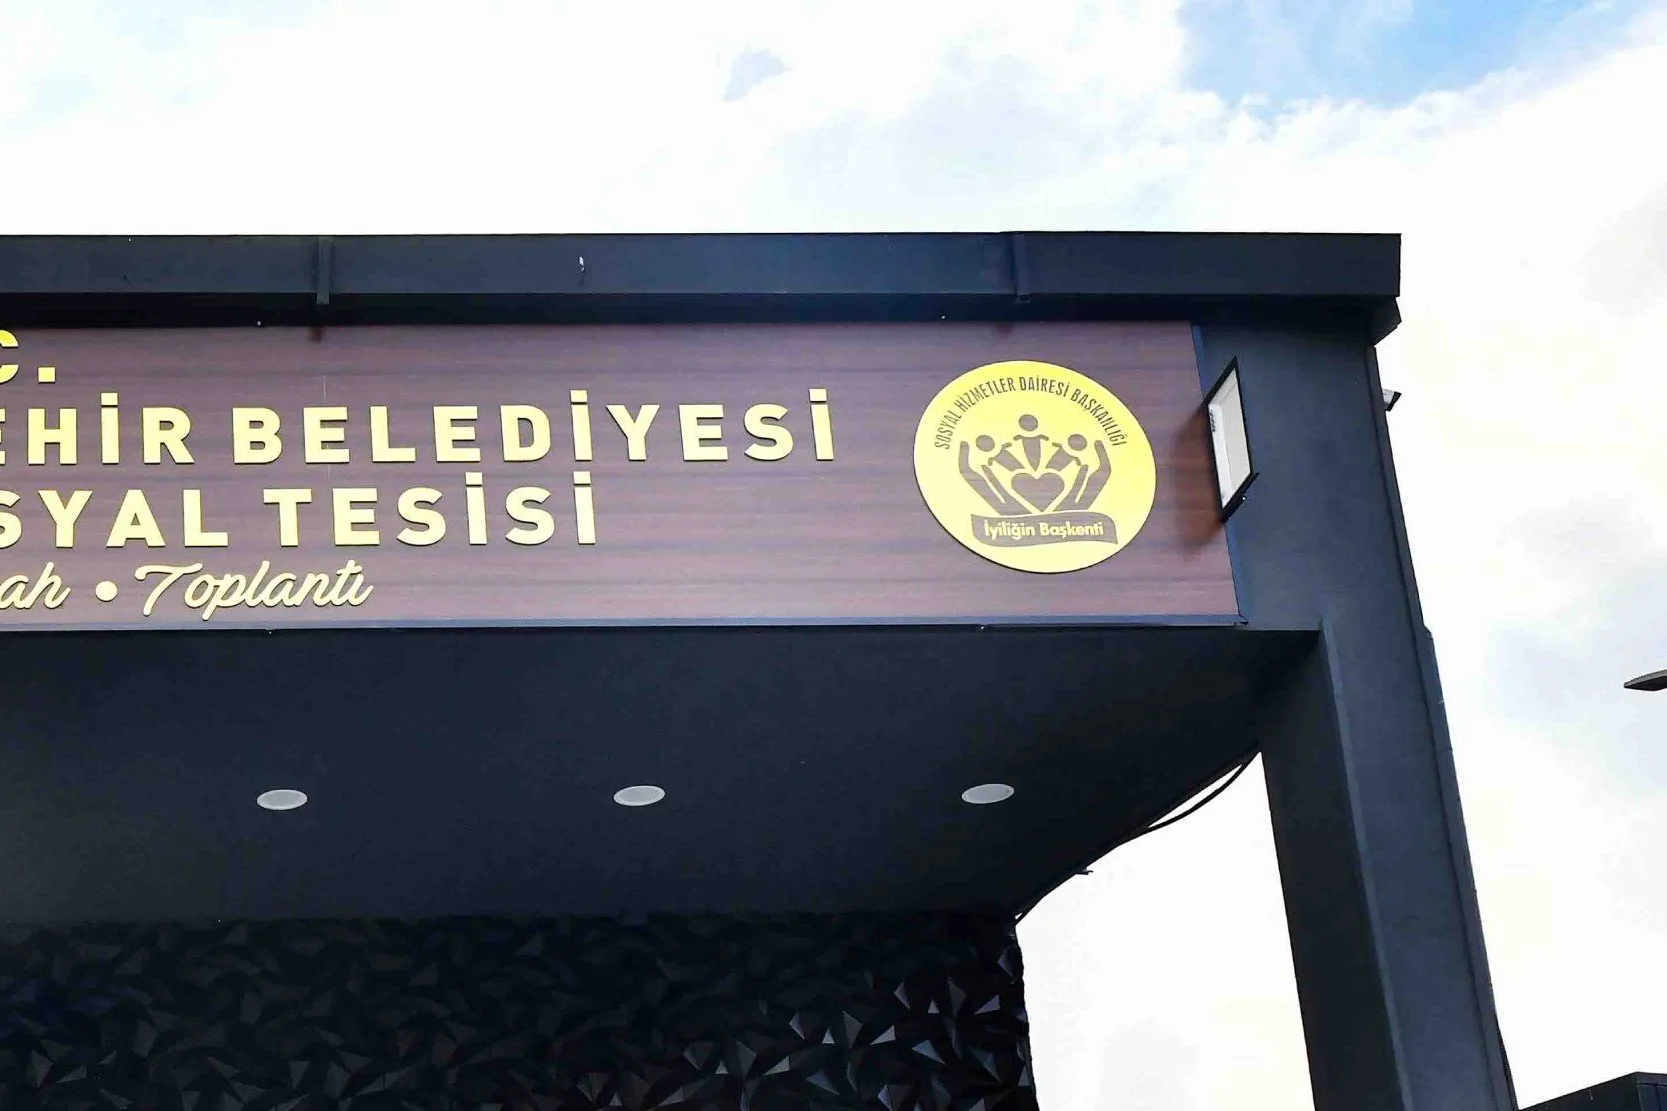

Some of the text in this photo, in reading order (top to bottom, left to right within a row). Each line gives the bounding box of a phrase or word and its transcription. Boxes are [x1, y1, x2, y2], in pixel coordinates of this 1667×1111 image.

[233, 388, 835, 464] BELEDİYESİ
[934, 374, 1128, 450] SOSYAL HİZMETLER DAİRESİ BAŞKANLIĞI
[263, 471, 596, 548] TESİSİ
[984, 520, 1104, 540] İyiliğin Başkenti
[134, 559, 375, 620] Toplantı
